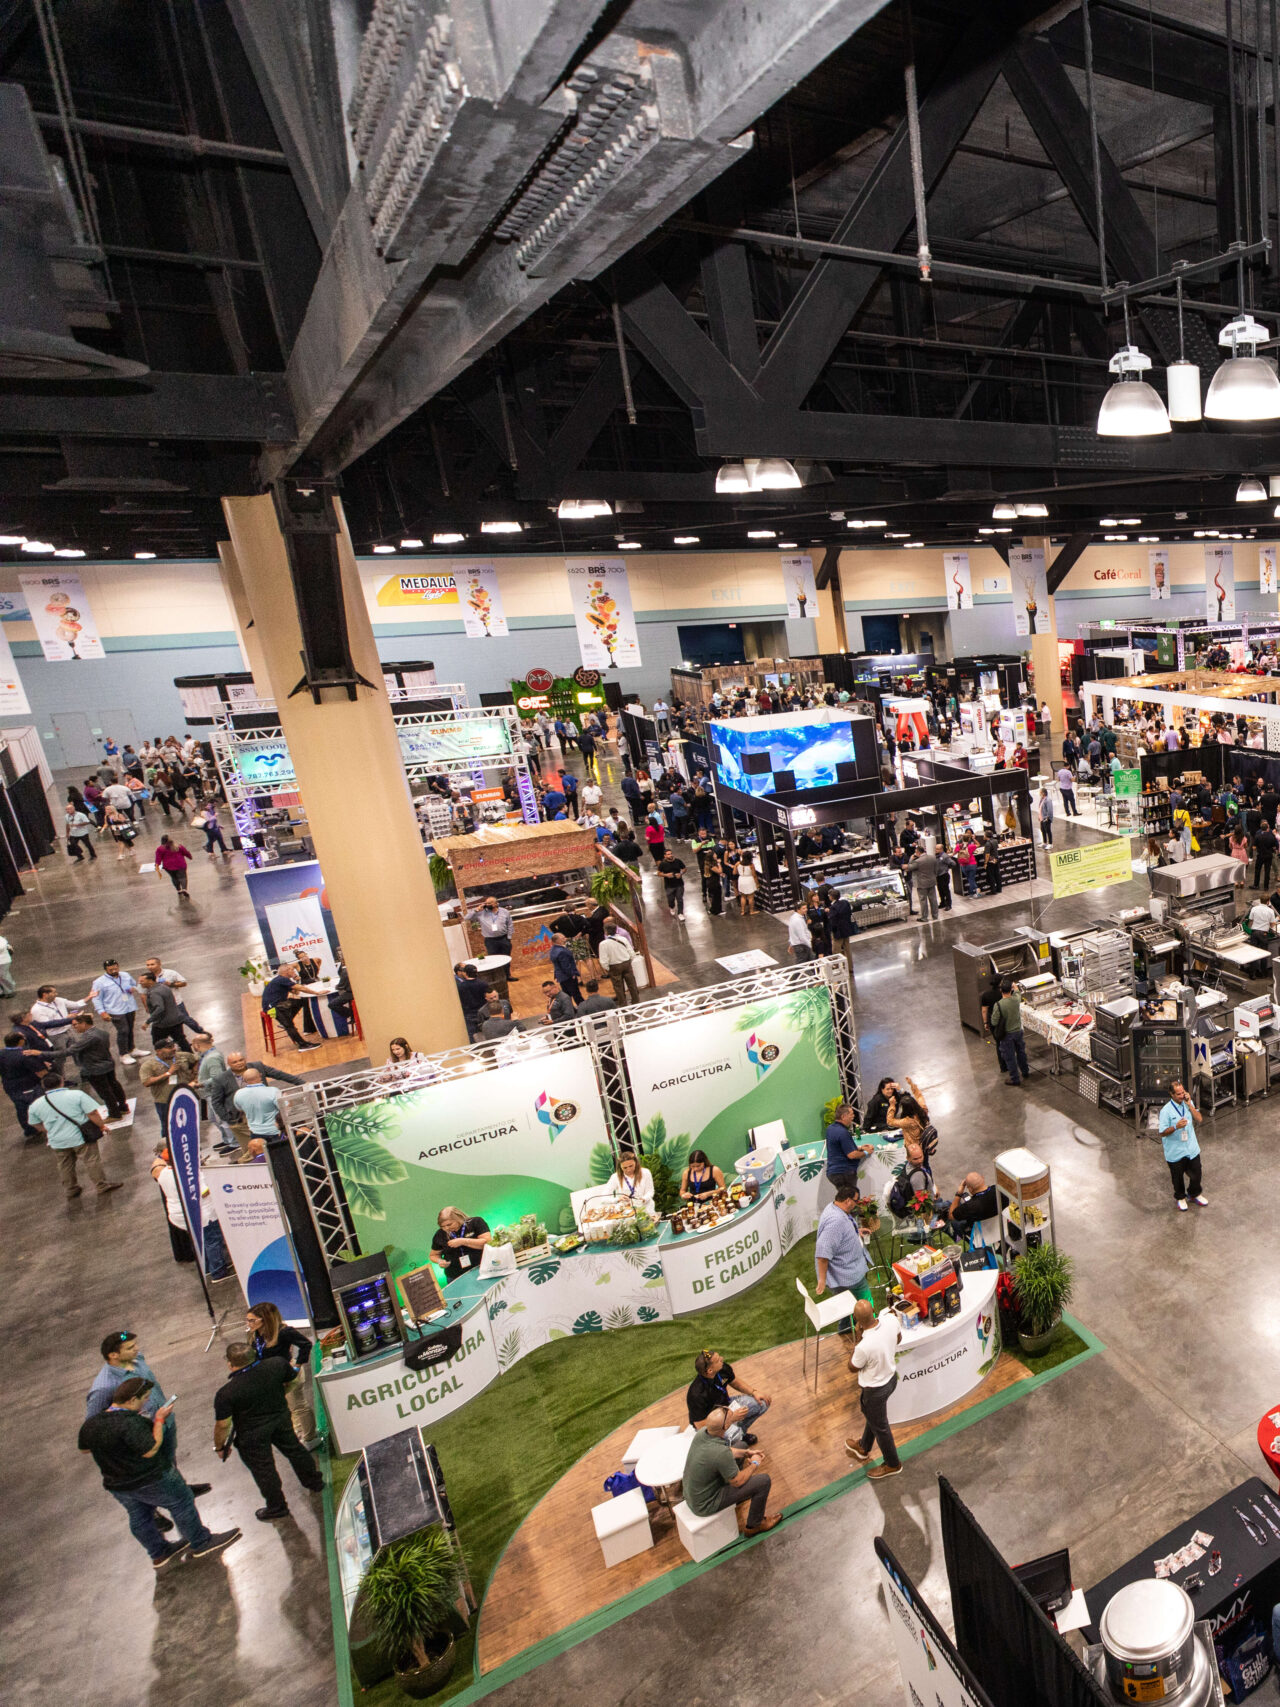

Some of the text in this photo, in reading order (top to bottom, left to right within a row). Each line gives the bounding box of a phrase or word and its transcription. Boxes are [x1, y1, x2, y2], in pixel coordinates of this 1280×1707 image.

[588, 566, 606, 574] BRS
[1094, 568, 1142, 581] Café Coral
[401, 576, 457, 590] MEDALLA
[711, 588, 742, 601] EXIT
[1058, 852, 1079, 865] MBE
[281, 937, 324, 952] EMPIRE
[651, 1063, 732, 1092] AGRICULTURA
[418, 1124, 519, 1160] AGRICULTURA
[180, 1133, 198, 1200] CROWLEY
[248, 1207, 275, 1215] possible
[261, 1213, 280, 1222] peopl
[704, 1229, 759, 1269] FRESCO
[692, 1239, 773, 1294] DE CALIDAD
[902, 1346, 968, 1382] AGRICULTURA
[396, 1375, 463, 1419] LOCAL
